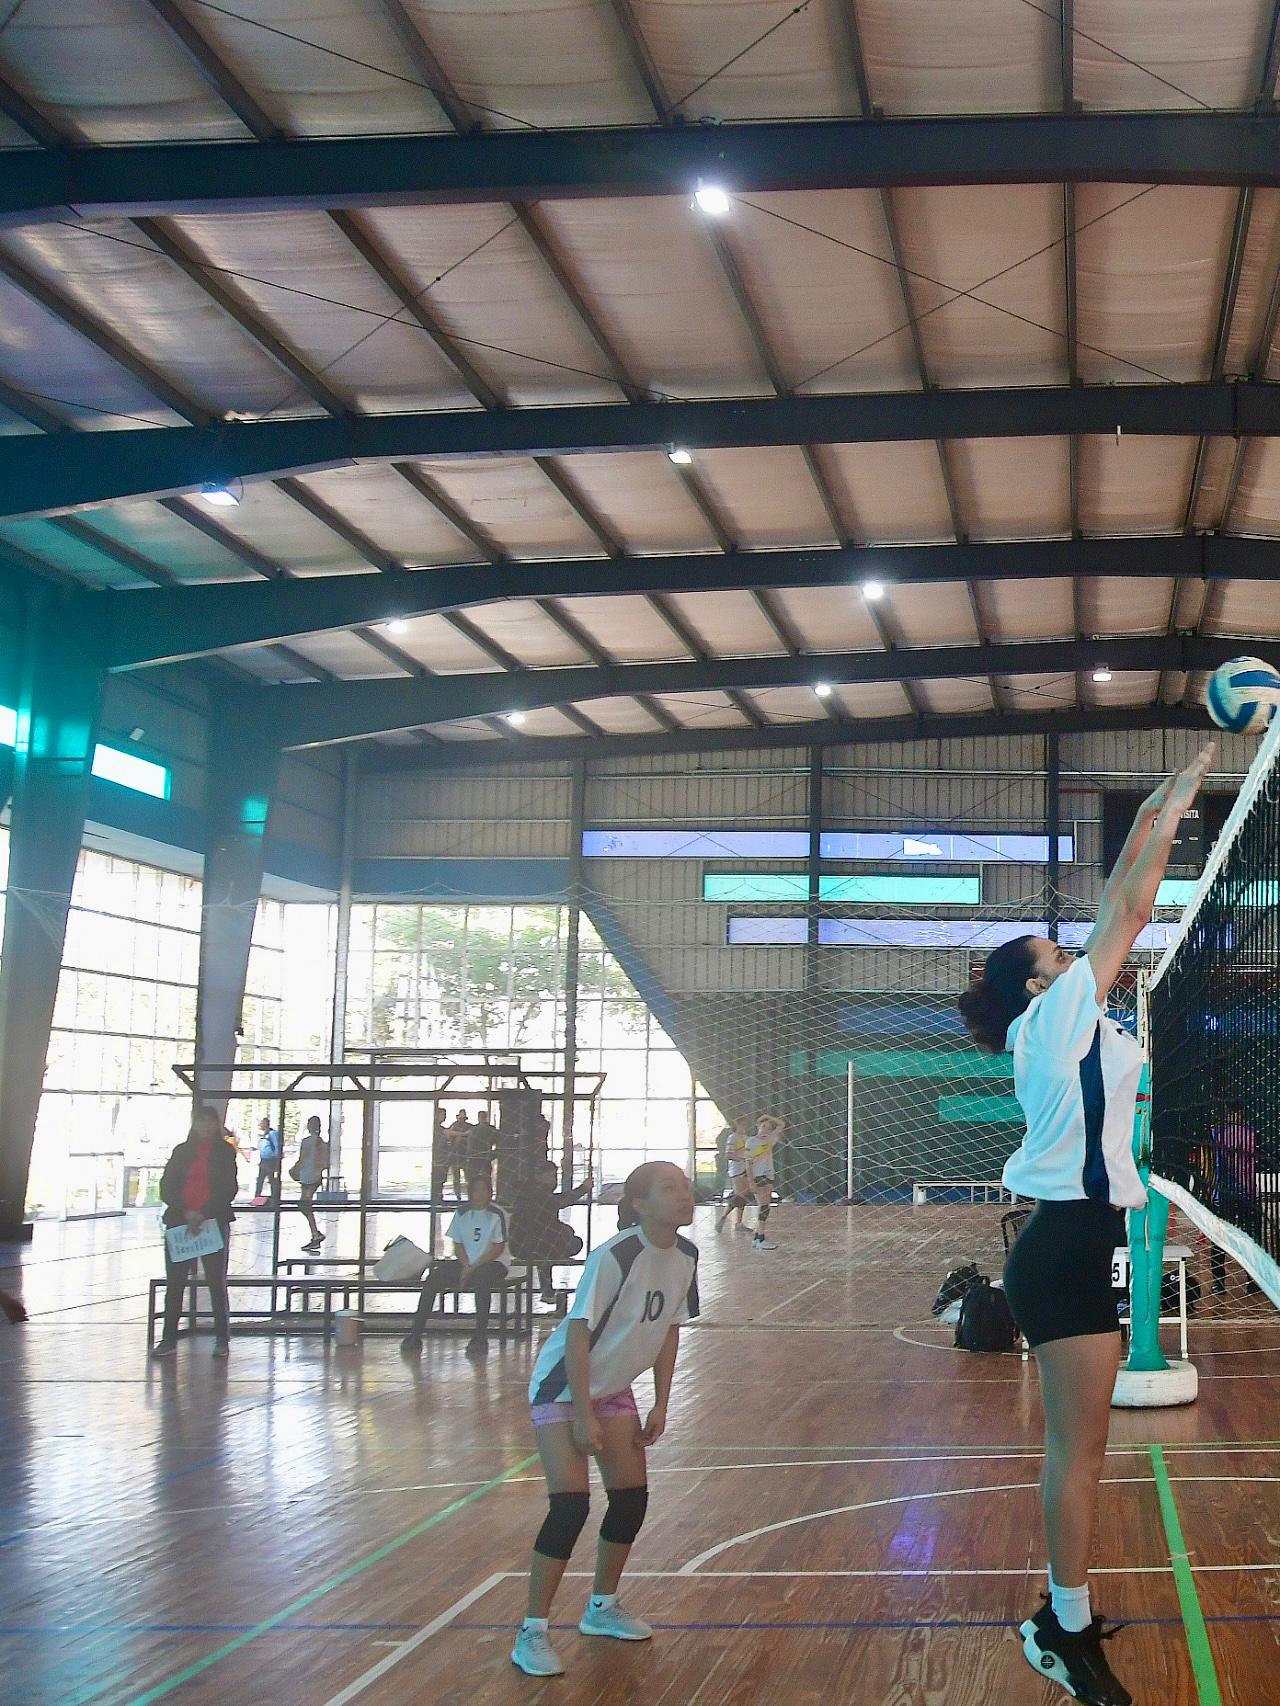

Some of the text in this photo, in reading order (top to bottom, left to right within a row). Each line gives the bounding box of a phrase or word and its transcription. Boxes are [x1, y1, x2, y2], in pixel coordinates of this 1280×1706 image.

[474, 1227, 481, 1242] 5
[1111, 1263, 1120, 1282] 5
[640, 1290, 664, 1323] 10
